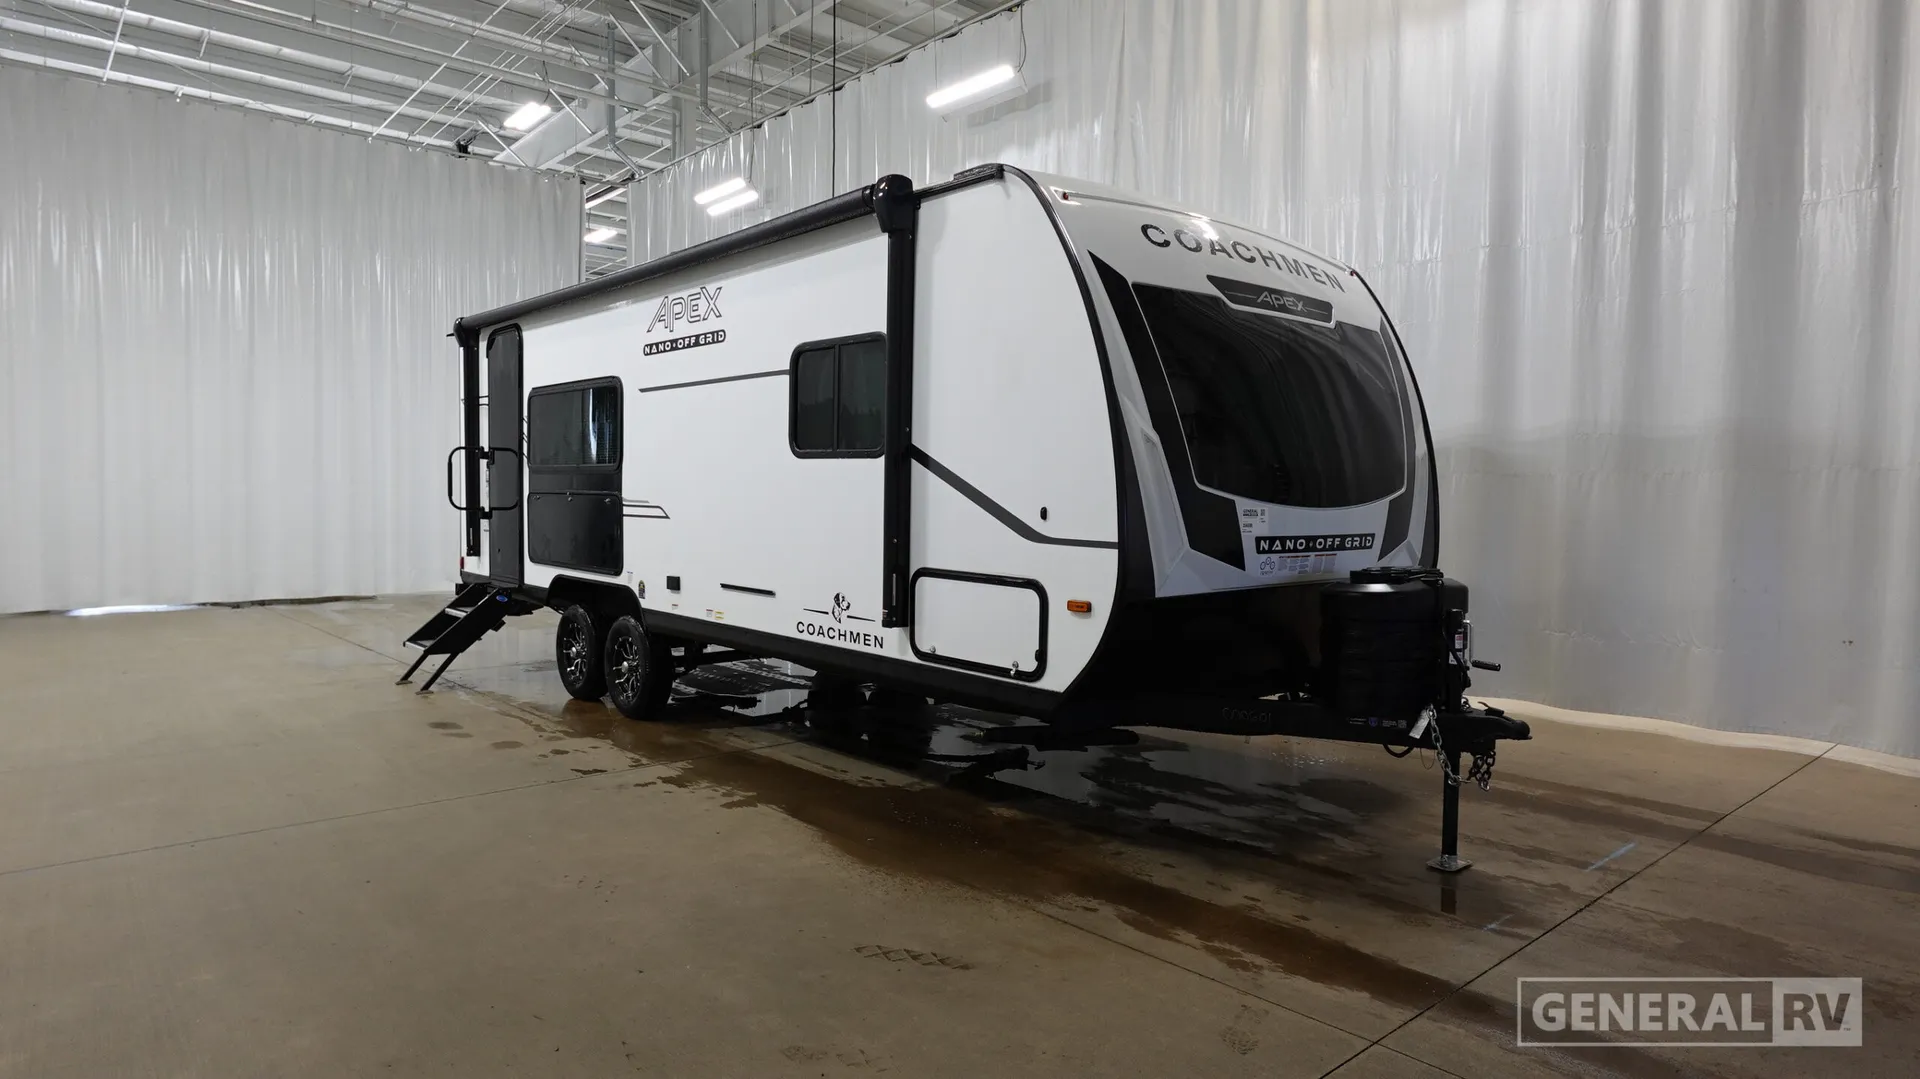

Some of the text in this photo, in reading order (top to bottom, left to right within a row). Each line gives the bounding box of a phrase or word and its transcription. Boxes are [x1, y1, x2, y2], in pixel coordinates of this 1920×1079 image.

[1140, 223, 1346, 293] COACHMEN
[646, 286, 723, 333] APEX
[1256, 290, 1308, 313] APEX
[644, 331, 725, 355] NANO OFF GRID
[1259, 536, 1373, 551] NANO OFF GRID
[796, 621, 884, 649] COACHMEN
